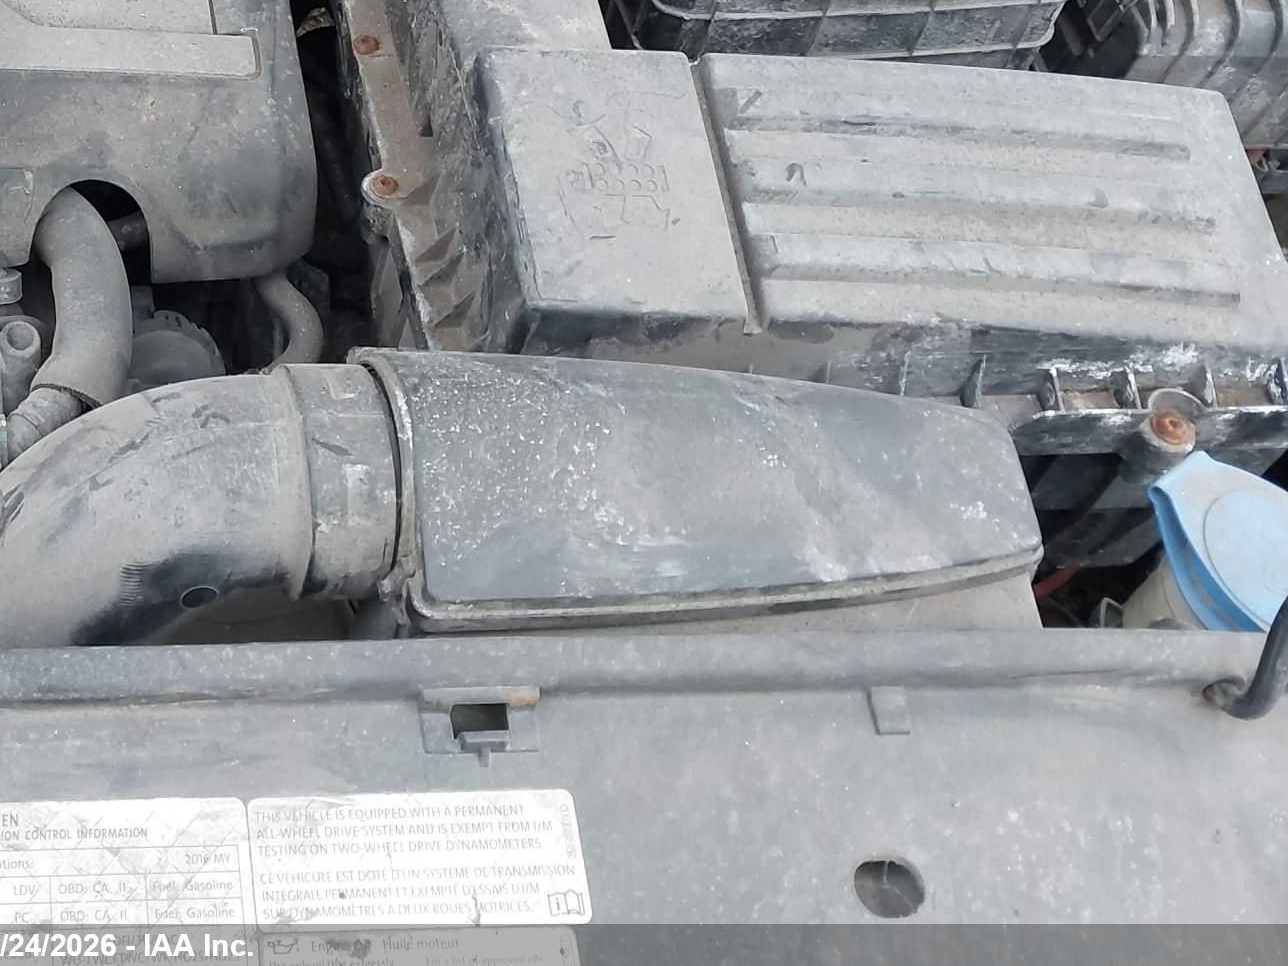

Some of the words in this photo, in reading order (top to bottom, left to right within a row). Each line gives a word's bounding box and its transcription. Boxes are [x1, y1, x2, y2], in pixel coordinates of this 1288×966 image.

[256, 811, 281, 823] THIS
[283, 809, 331, 822] VEHICLE
[336, 809, 346, 821] IS
[349, 808, 407, 823] EQUIPPED
[409, 806, 441, 818] WITH
[444, 806, 452, 817] A
[454, 805, 523, 817] PERMANENT
[25, 828, 72, 841] CONTROL
[77, 826, 148, 840] INFORMATION
[256, 826, 321, 839] ALL-WHEEL
[324, 826, 358, 837] DRIVE
[359, 825, 405, 836] SYSTEM
[407, 824, 434, 835] AND
[438, 823, 448, 834] IS
[451, 822, 495, 834] EXEMPT
[498, 821, 530, 832] FROM
[257, 844, 306, 857] TESTING
[310, 844, 327, 855] ON
[331, 841, 405, 854] TWO-WHEEL
[408, 840, 442, 851] DRIVE
[214, 853, 230, 863] MY
[260, 873, 274, 884] CE
[336, 869, 355, 881] EST
[475, 866, 490, 877] DE
[491, 864, 576, 877] TRANSMISSION
[14, 884, 35, 896] LDV
[185, 879, 233, 892] Gasoline
[15, 912, 29, 923] PC
[187, 905, 235, 918] Gasoline
[417, 938, 459, 948] moteur
